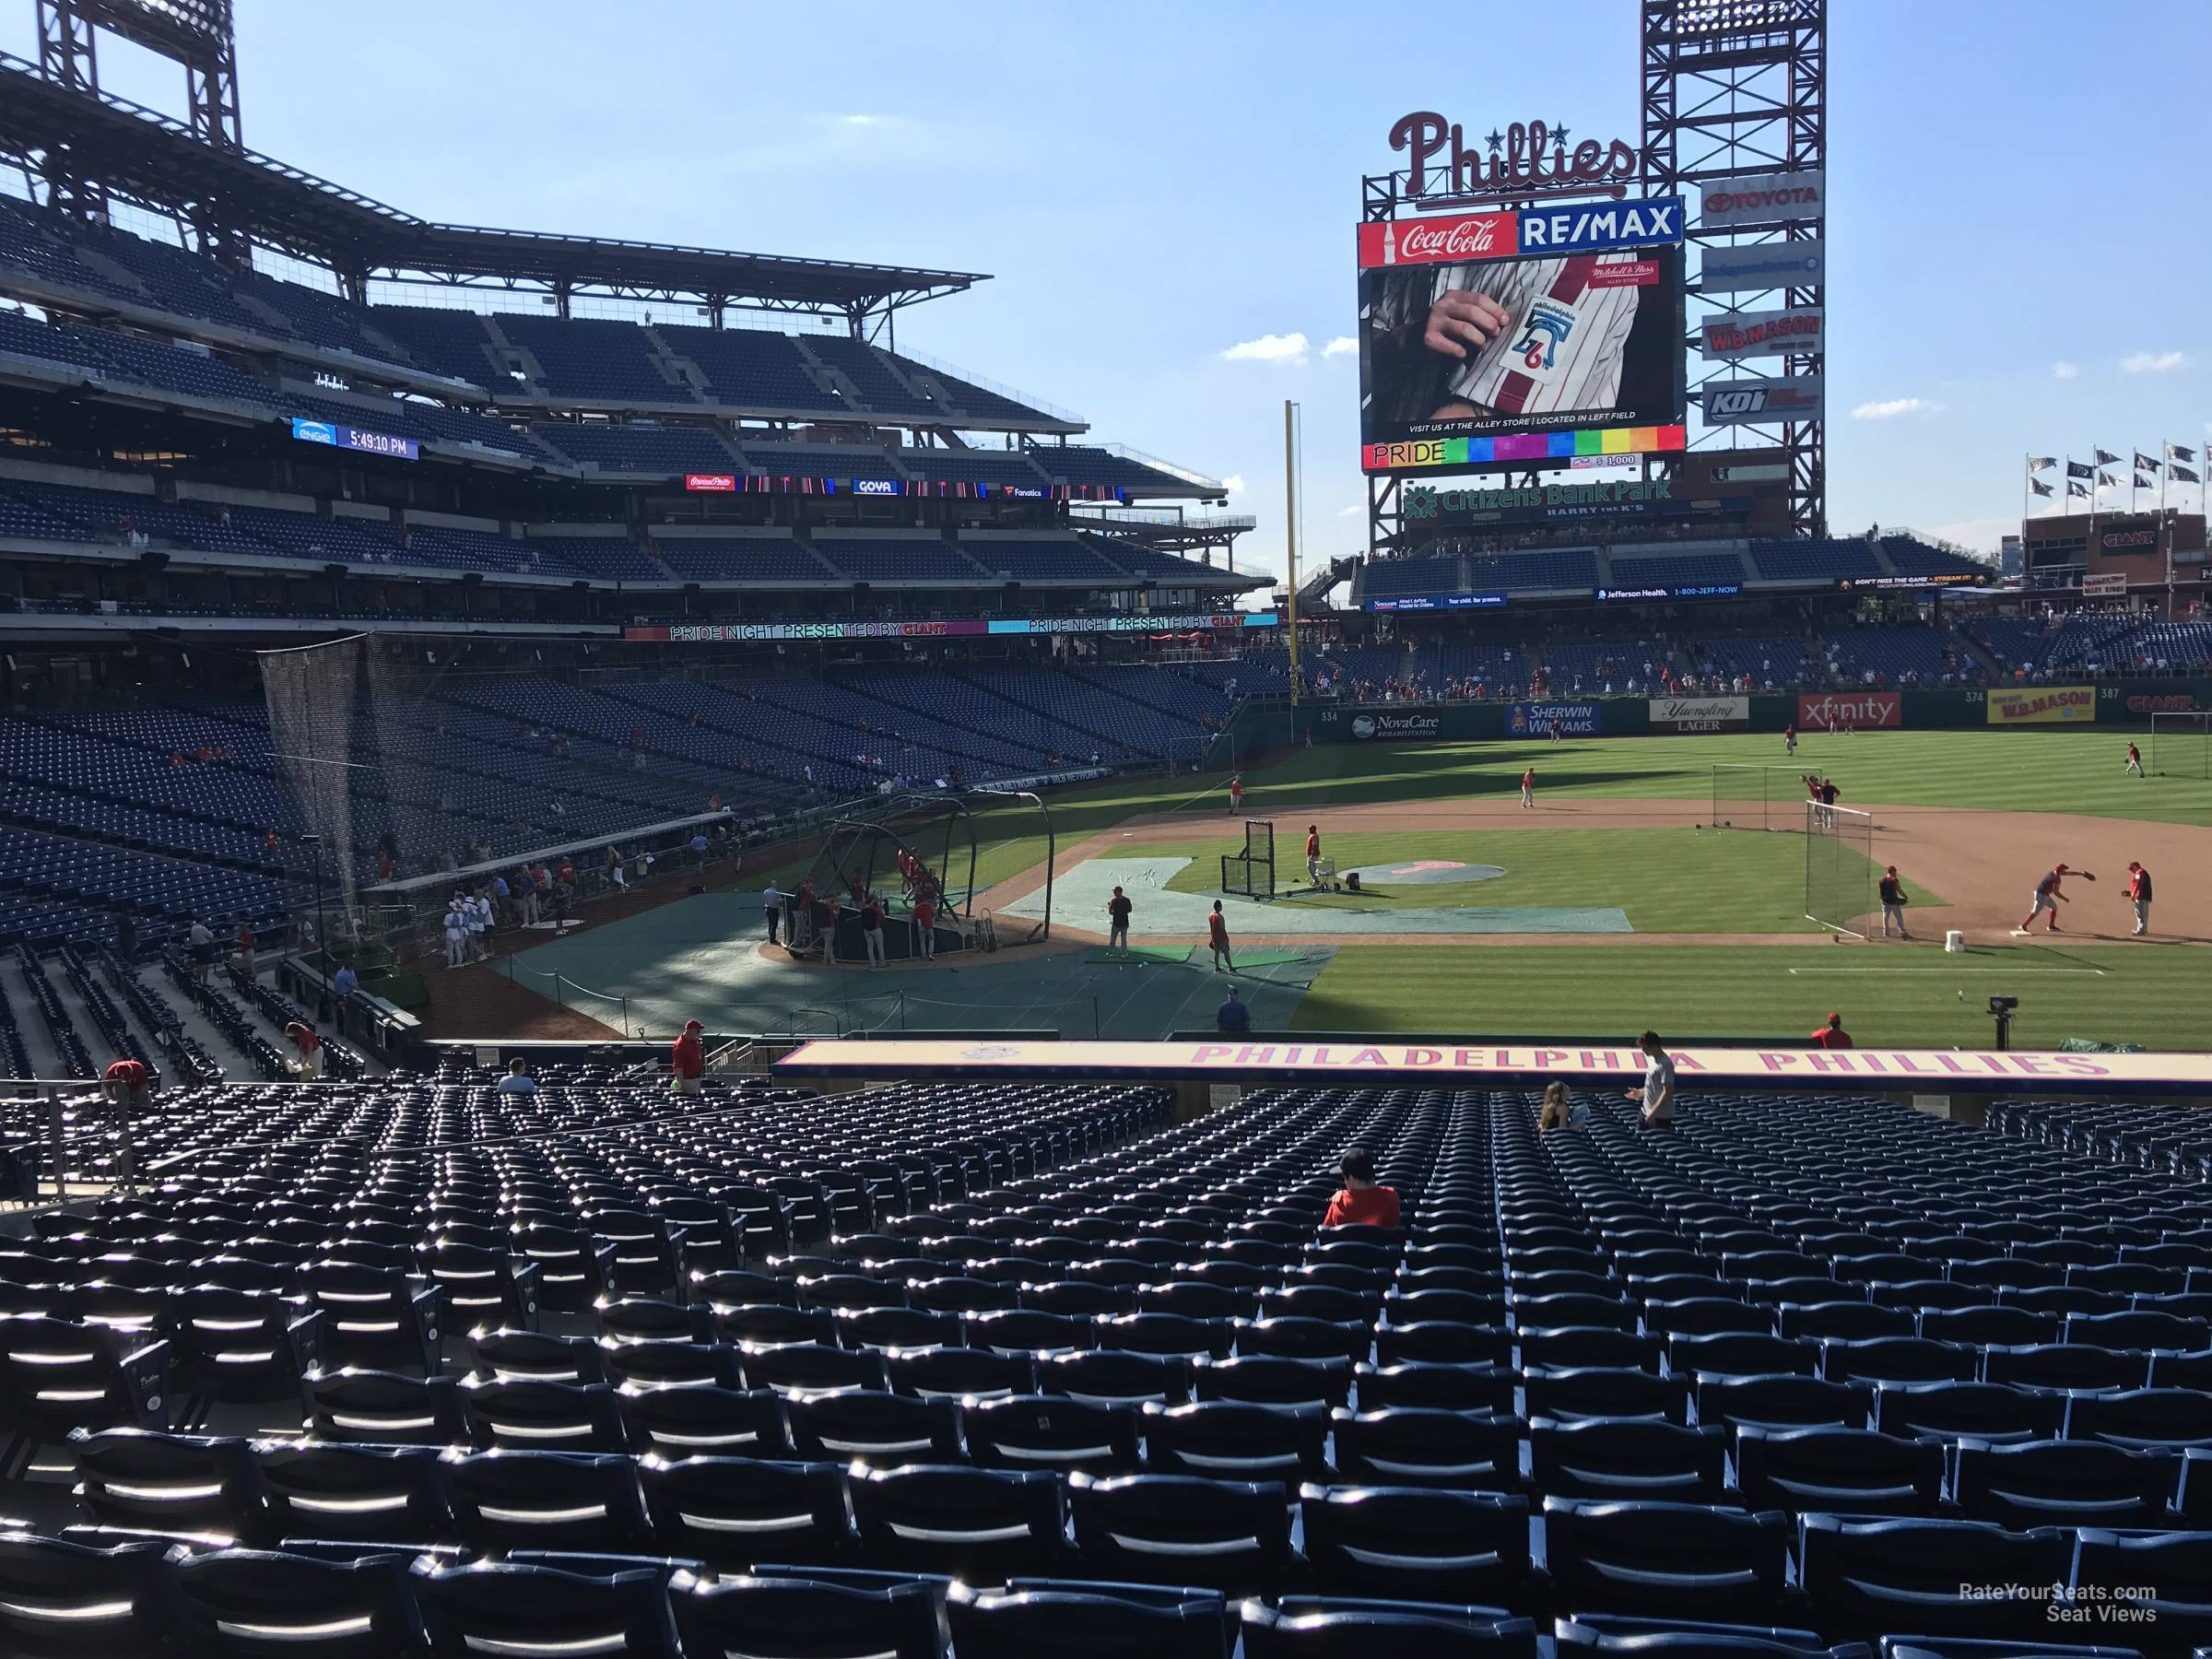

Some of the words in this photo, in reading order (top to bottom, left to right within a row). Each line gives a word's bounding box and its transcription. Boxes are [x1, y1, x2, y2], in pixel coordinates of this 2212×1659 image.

[1388, 111, 1637, 196] Phillies
[1733, 187, 1818, 208] TOYOTA
[1524, 206, 1673, 246] RE/MAX
[1402, 219, 1500, 257] Coca-Cola
[1409, 424, 1430, 433] VISIT
[1457, 422, 1474, 430] THE
[1475, 420, 1502, 429] ALLEY
[1502, 418, 1531, 427] STORE
[1536, 415, 1576, 425] LOCATED
[1577, 414, 1587, 422] IN
[1588, 413, 1610, 421] LEFT
[1611, 411, 1636, 419] FIELD
[350, 430, 388, 451] 5:49:10
[391, 438, 406, 454] PM
[1373, 441, 1447, 465] PRIDE
[1606, 455, 1635, 466] 1,000
[858, 480, 892, 492] GOYA
[1014, 488, 1042, 497] Fanatics
[1442, 488, 1542, 512] Citizens
[1547, 479, 1611, 506] Bank
[1615, 477, 1672, 501] Park
[1547, 506, 1598, 516] HARRY
[1621, 504, 1644, 512] K'S
[2102, 531, 2155, 547] GIANT
[1607, 590, 1641, 598] Jefferson
[1675, 586, 1738, 595] 1-800-JEFF-NOW
[670, 626, 724, 641] PRIDE
[726, 624, 777, 641] NIGHT
[783, 622, 877, 639] PRESENTED
[879, 622, 902, 636] BY
[902, 621, 947, 636] GIANT
[1029, 619, 1069, 633] PRIDE
[1072, 618, 1110, 632] NIGHT
[1115, 616, 1190, 630] PRESENTED
[1193, 616, 1208, 629] BY
[1211, 615, 1247, 627] GIANT
[1965, 691, 1983, 703] 374
[2100, 688, 2120, 700] 387
[1530, 705, 1593, 719] SHERWIN
[1661, 699, 1738, 719] Yuengling
[2125, 695, 2195, 712] GIANT
[1321, 712, 1337, 723] 334
[1376, 714, 1439, 729] NovaCare
[1677, 720, 1722, 732] LAGER
[1377, 729, 1437, 737] REHABILITATION
[1003, 778, 1039, 791] NETWORK
[1066, 770, 1100, 782] NETWORK
[1191, 1045, 1708, 1071] PHILADELPHIA
[1756, 1053, 2112, 1076] PHILLIES
